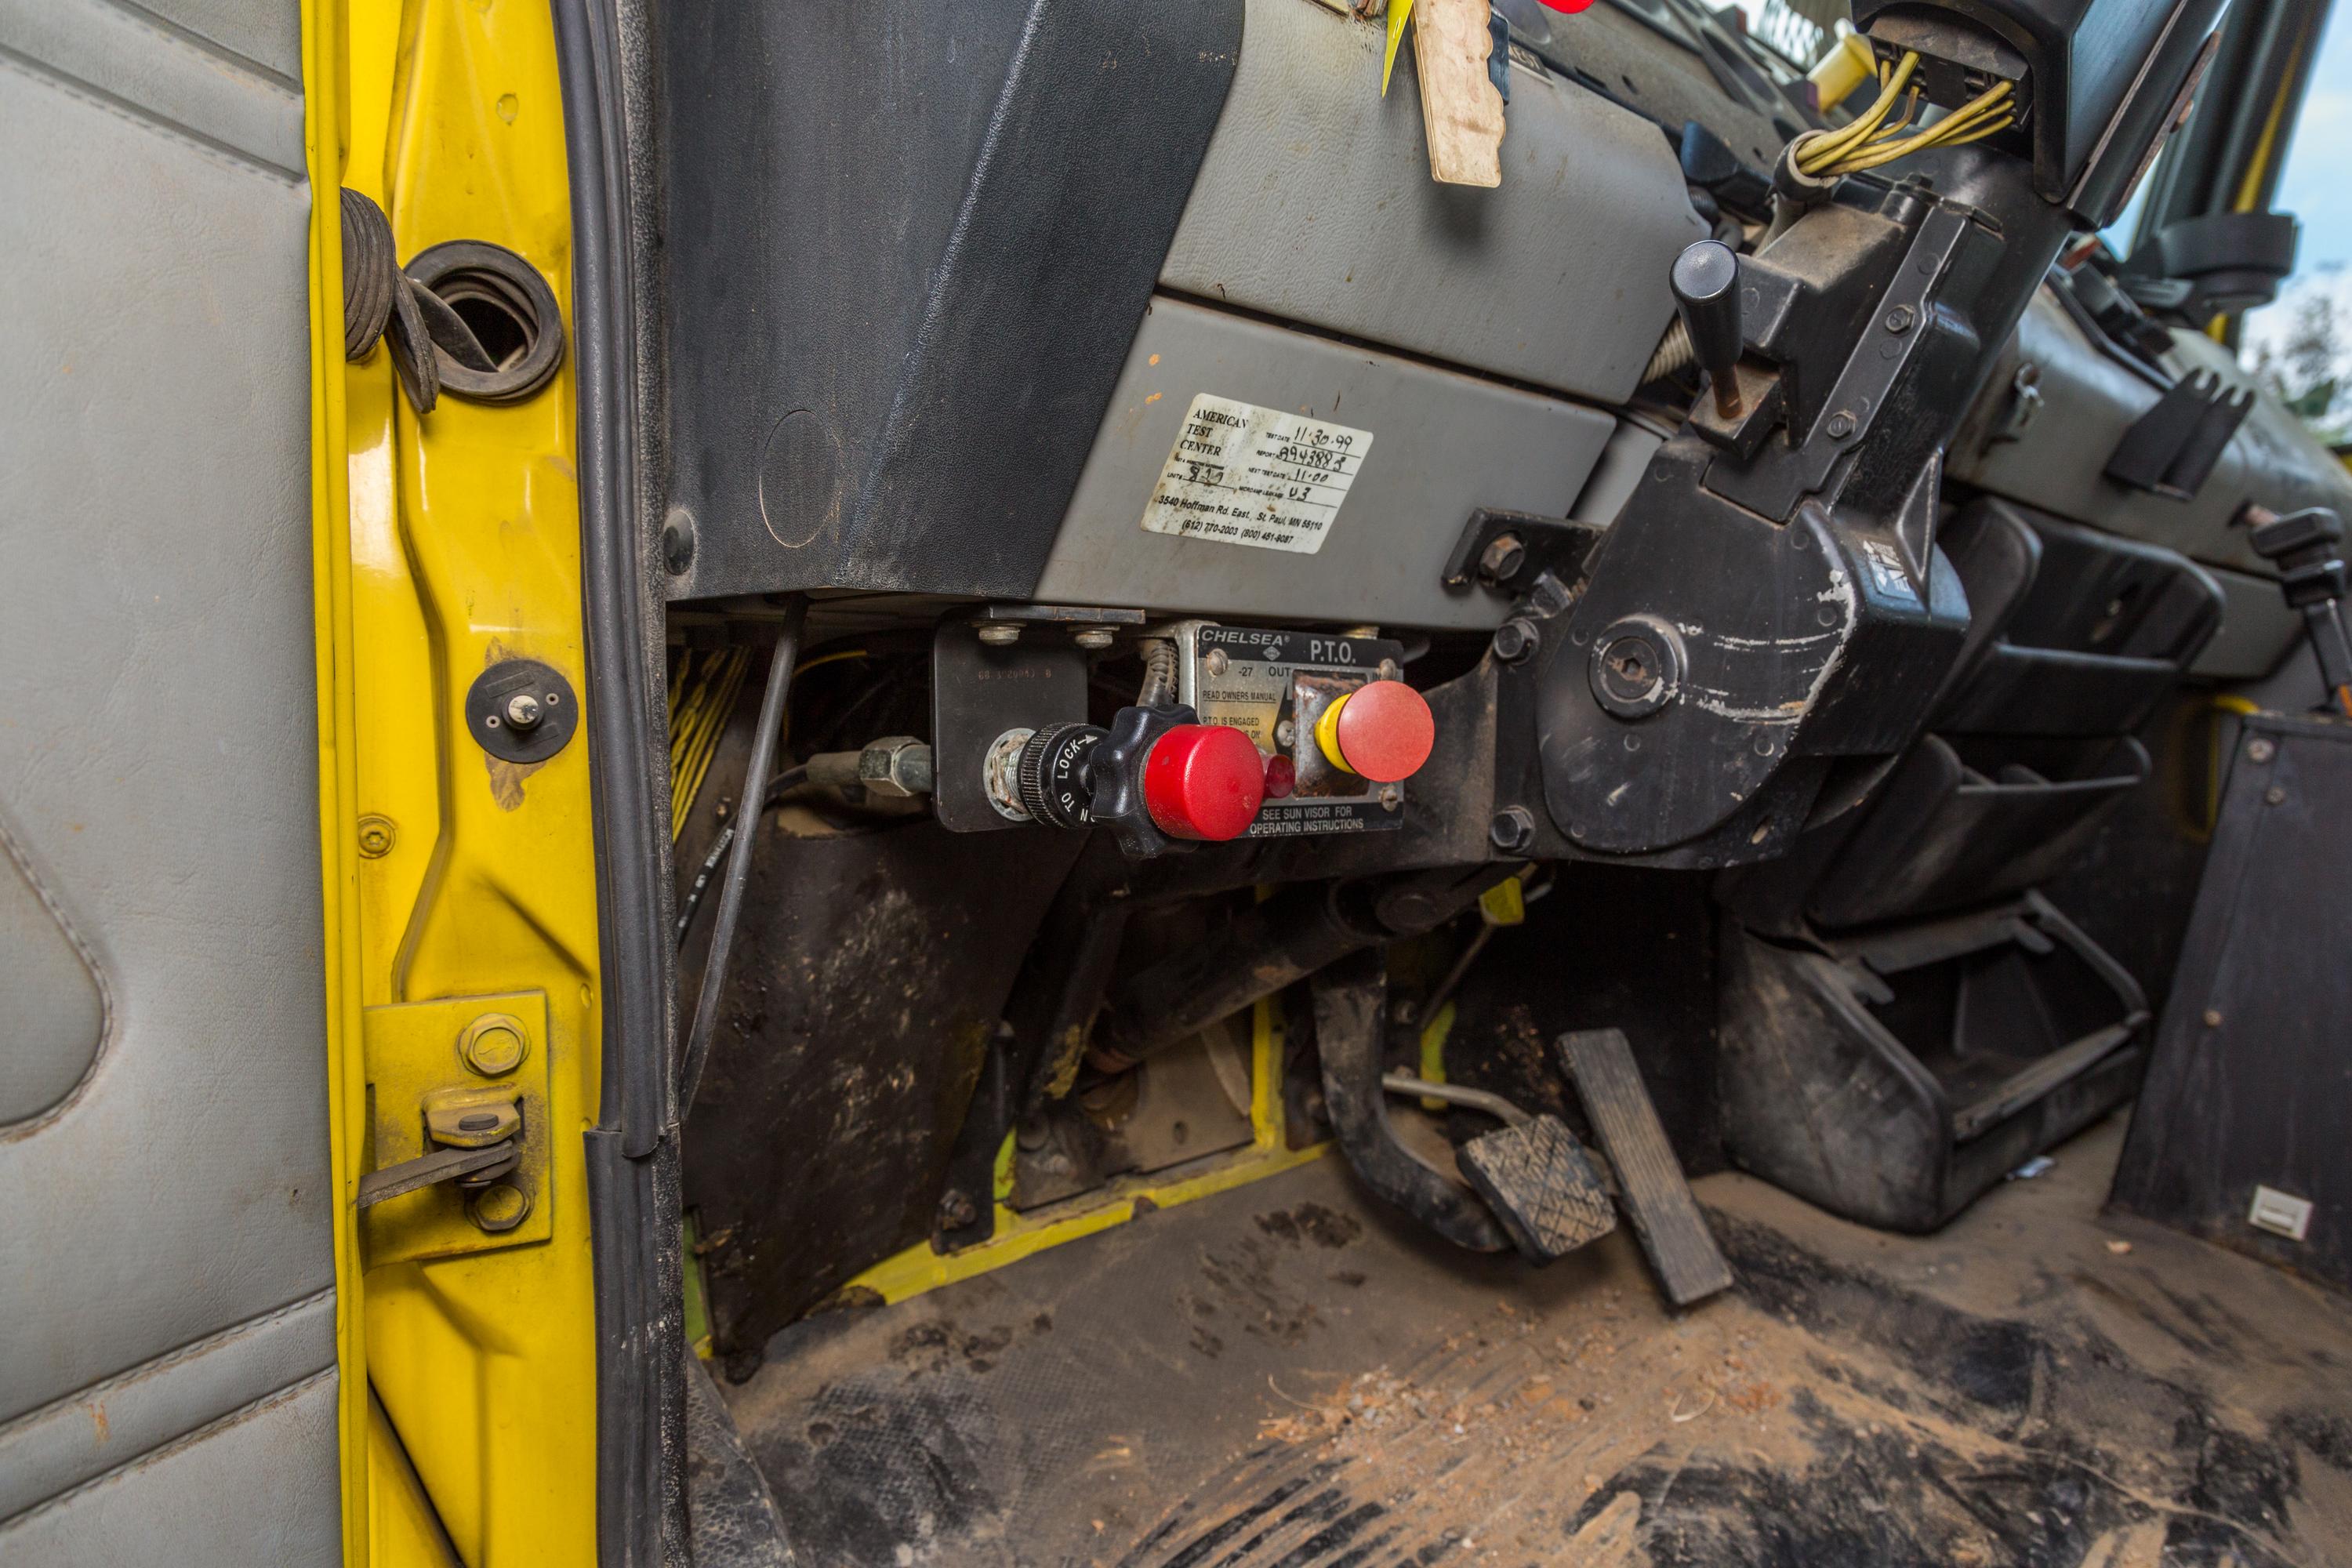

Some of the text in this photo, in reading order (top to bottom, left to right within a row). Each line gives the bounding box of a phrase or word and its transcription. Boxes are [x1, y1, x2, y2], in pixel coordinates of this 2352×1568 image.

[1192, 408, 1249, 429] AMERICAN
[1187, 423, 1214, 438] TEST
[1180, 439, 1222, 456] CENTER
[1256, 449, 1276, 458] REPORT
[1159, 495, 1179, 506] 3540
[1179, 499, 1215, 513] Hoffman
[1216, 505, 1229, 515] Rd.
[1288, 517, 1301, 528] MN
[1181, 519, 1203, 532] (612)
[1204, 523, 1239, 535] 770-2003
[1241, 528, 1261, 541] (800)
[1311, 640, 1357, 664] P.T.O.
[1268, 666, 1291, 677] OUT
[1203, 690, 1276, 701] READ OWNERS MANUAL
[1221, 717, 1228, 725] IS
[1229, 717, 1260, 726] ENGAGED
[1057, 739, 1080, 812] TO LOCK
[1262, 806, 1352, 821] SEE SUN VISOR FOR
[1250, 818, 1364, 835] OPERATING INSTRUCTIONS
